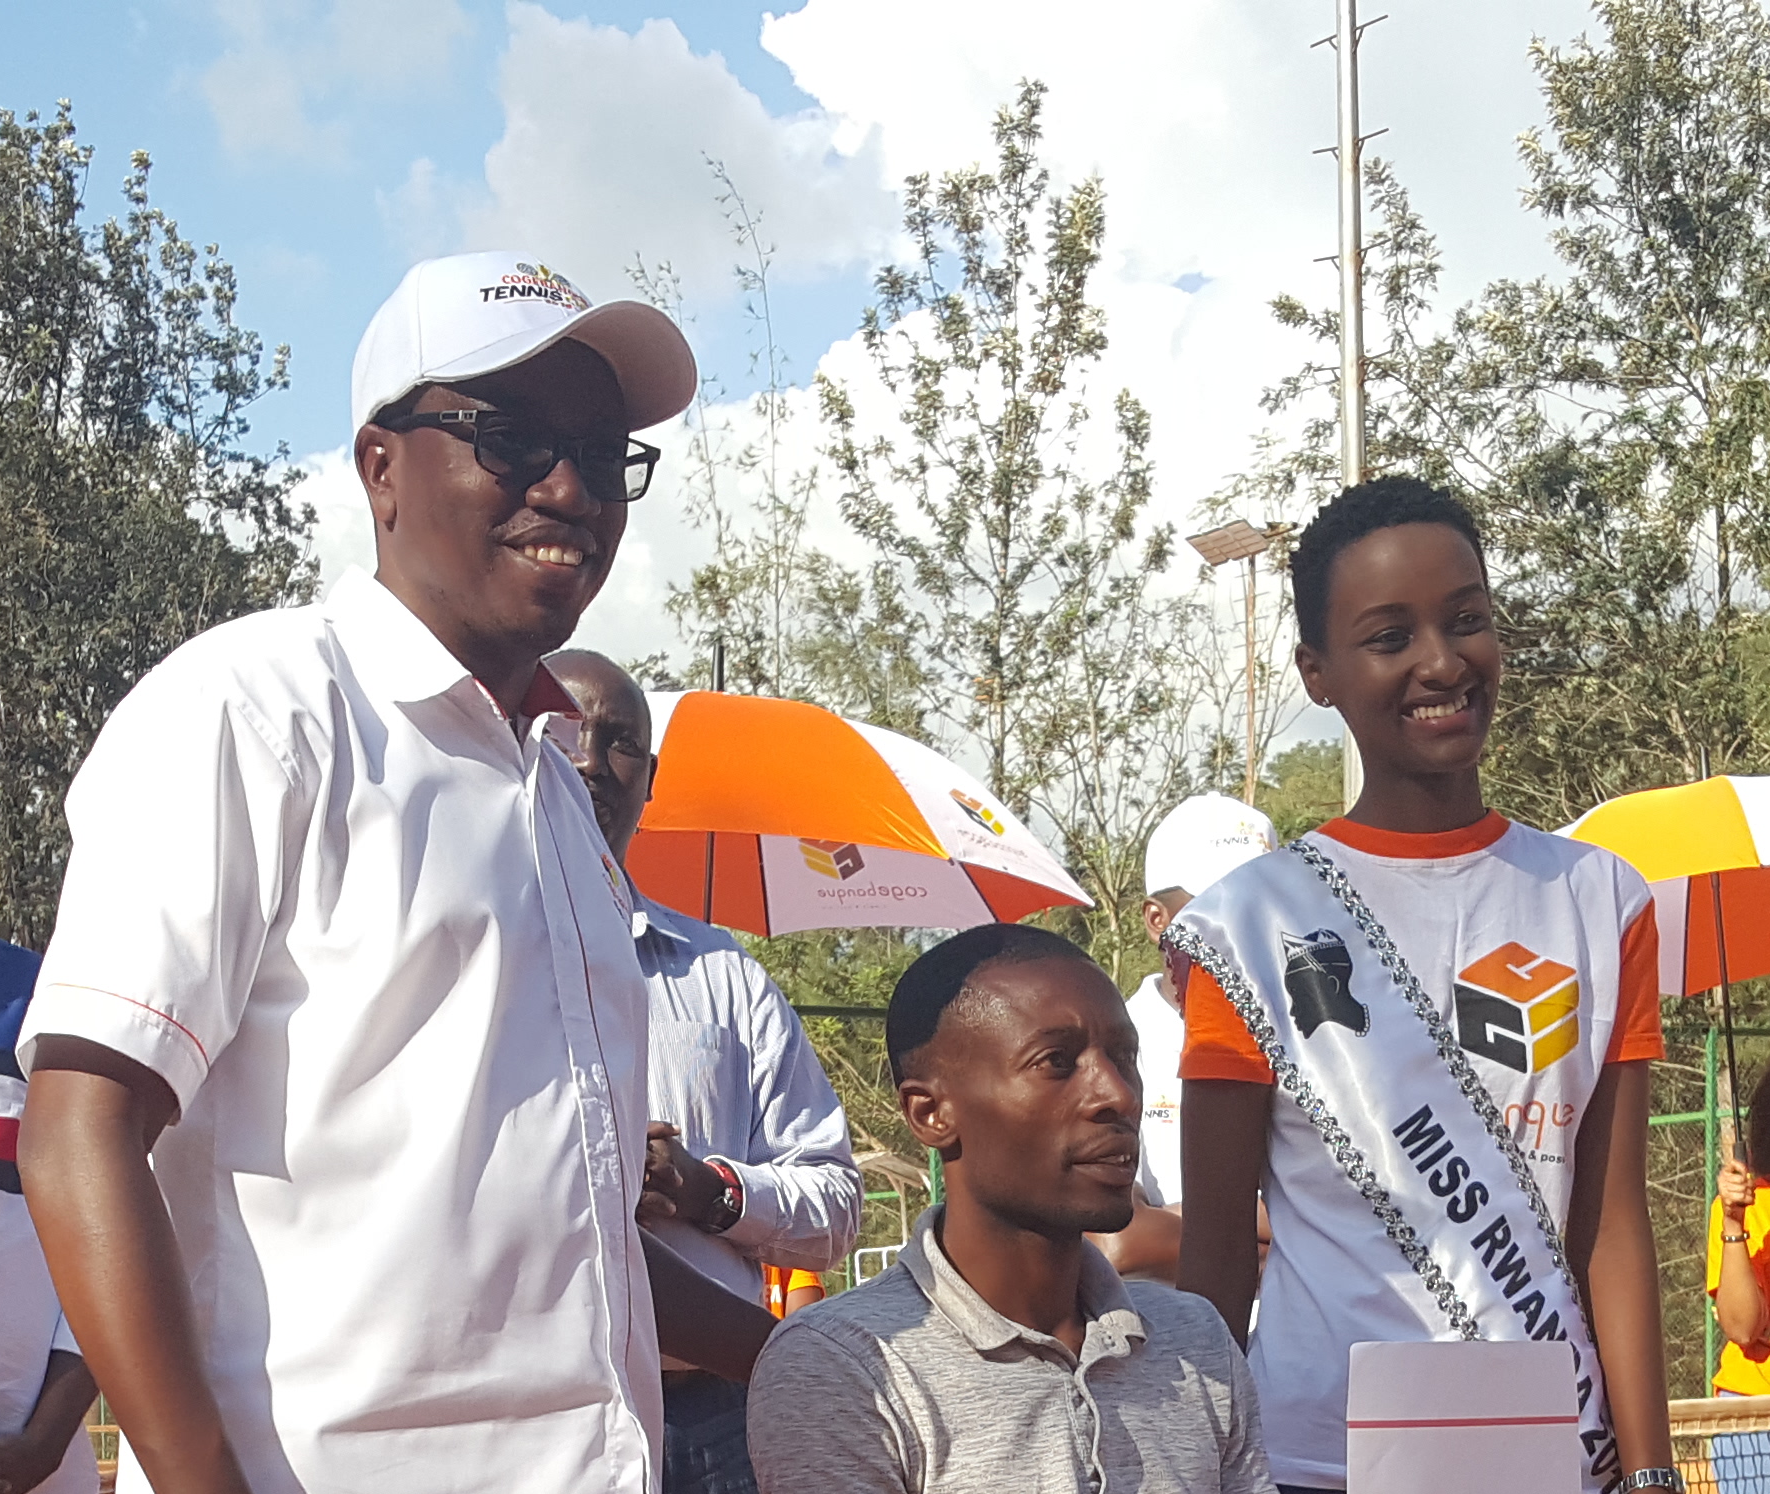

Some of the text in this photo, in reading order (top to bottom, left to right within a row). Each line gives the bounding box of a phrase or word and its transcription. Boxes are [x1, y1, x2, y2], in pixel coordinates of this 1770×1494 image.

[479, 284, 564, 303] TENNIS
[1392, 1103, 1490, 1224] MISS
[1470, 1214, 1593, 1418] RWANA
